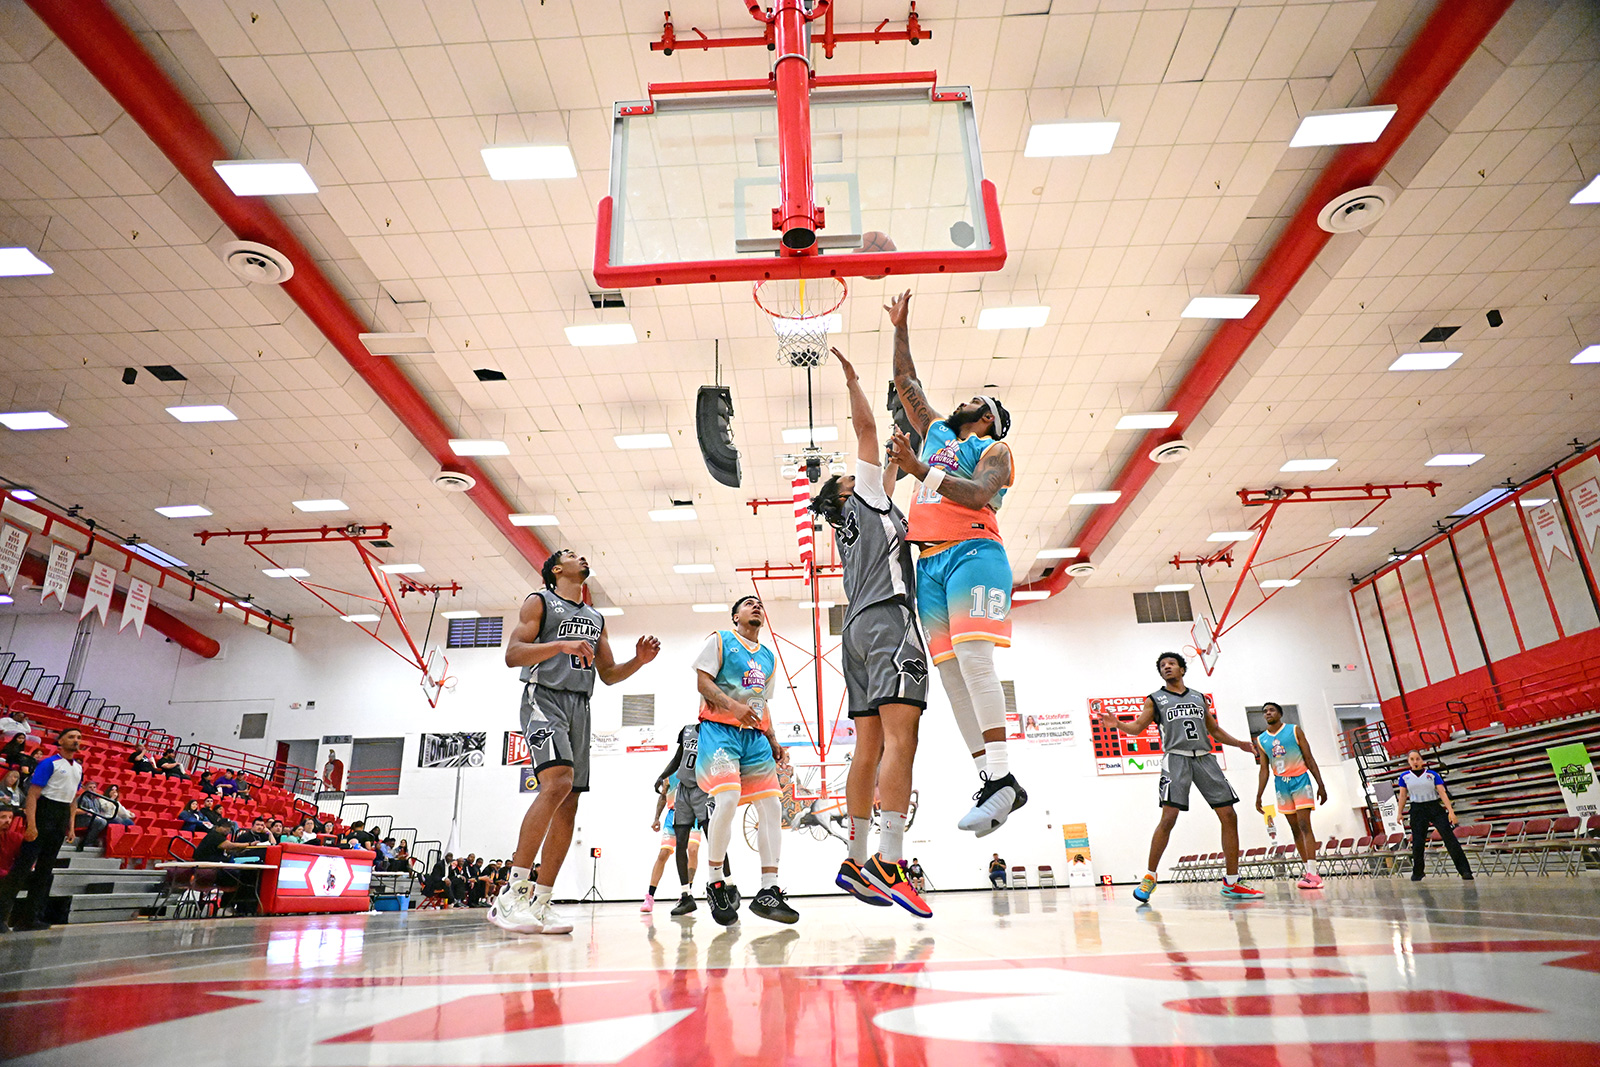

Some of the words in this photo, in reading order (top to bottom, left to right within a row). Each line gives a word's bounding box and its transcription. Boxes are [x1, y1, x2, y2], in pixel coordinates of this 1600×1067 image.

[970, 585, 1006, 622] 12
[1167, 708, 1204, 721] OUTLAWS
[1183, 719, 1200, 741] 2
[685, 752, 698, 770] 0
[1102, 875, 1112, 884] 12
